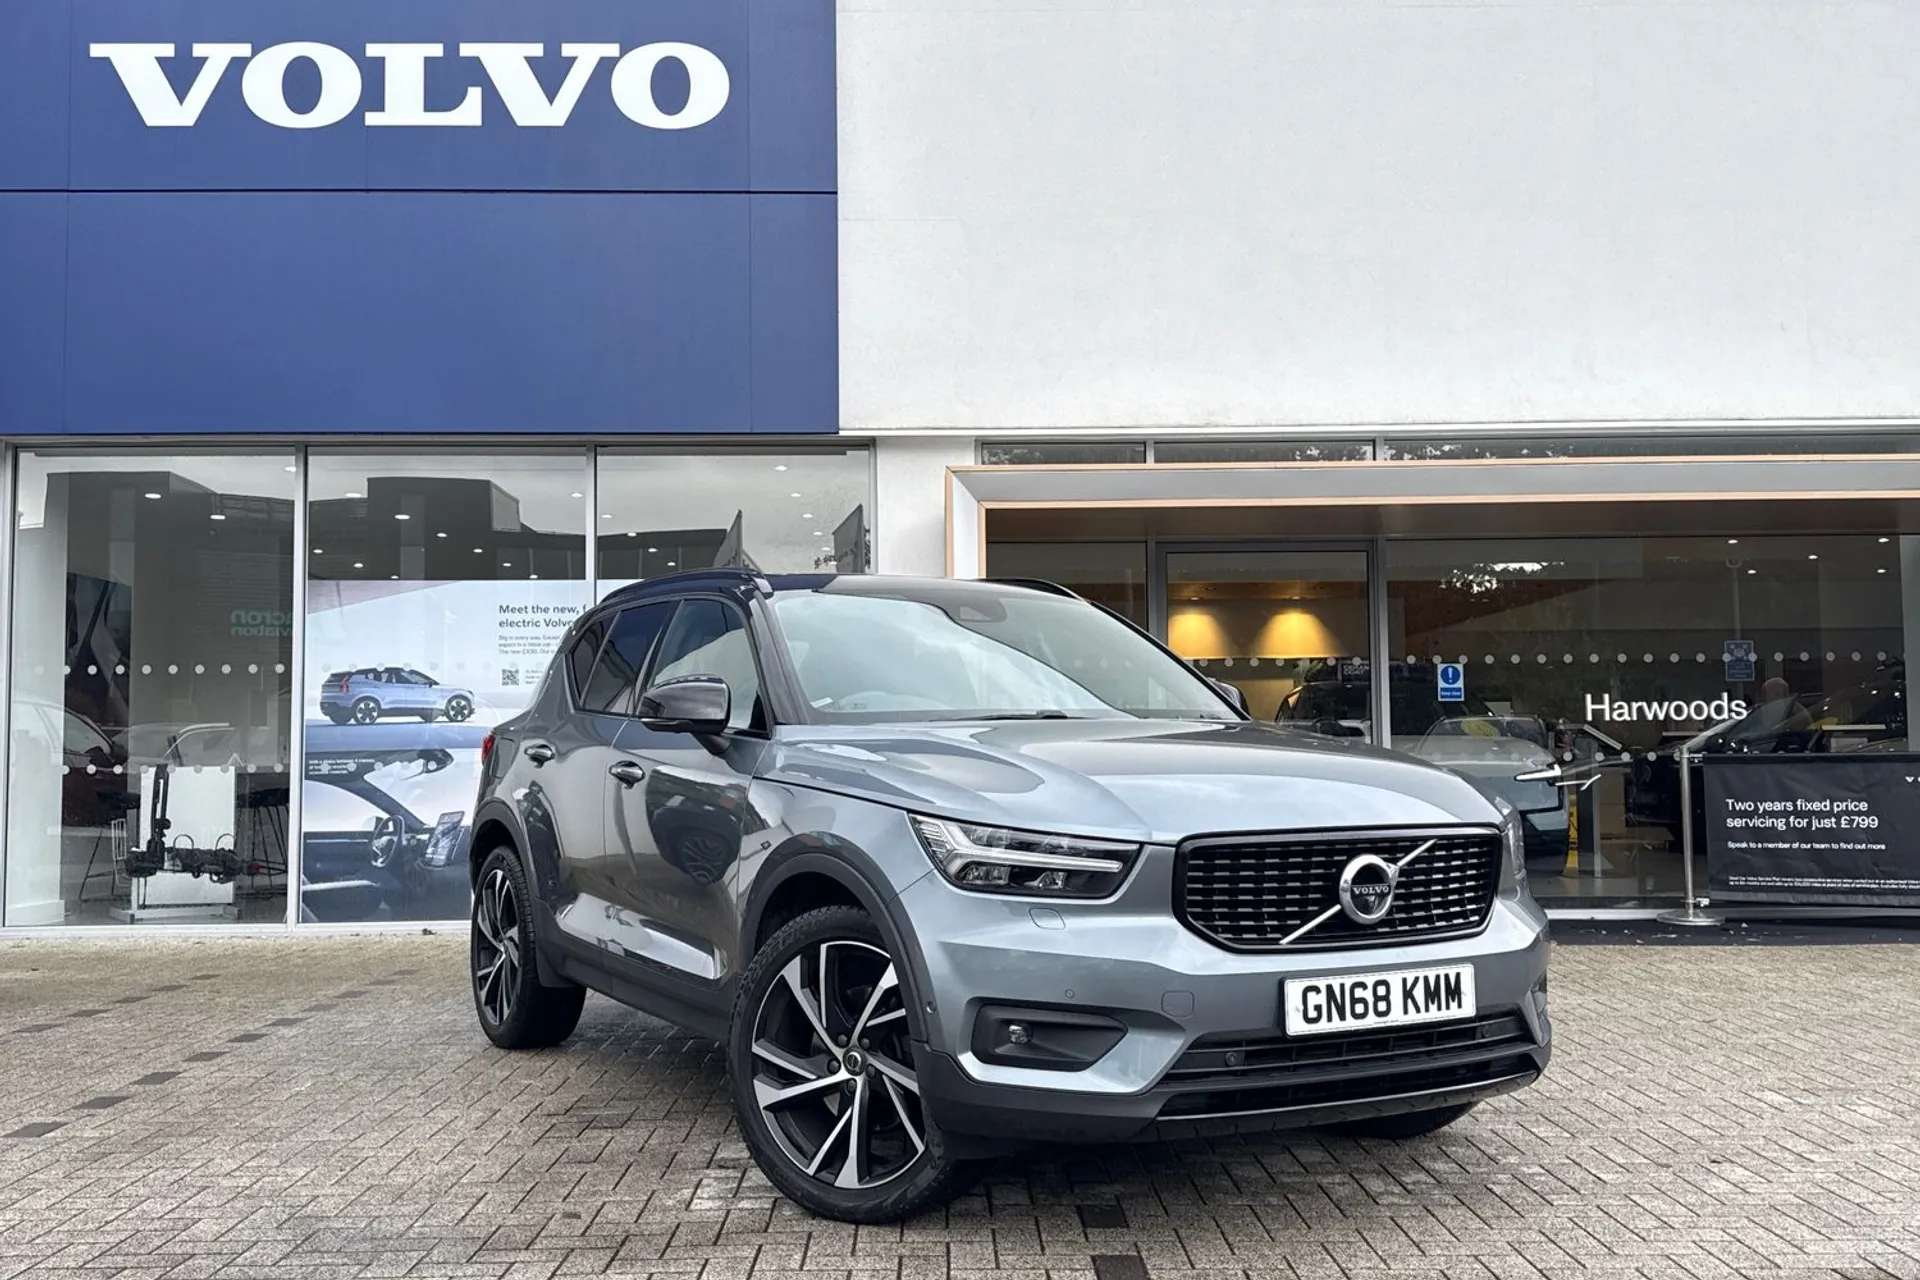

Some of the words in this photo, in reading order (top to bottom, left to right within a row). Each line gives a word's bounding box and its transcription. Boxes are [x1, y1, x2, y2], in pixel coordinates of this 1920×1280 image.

[90, 42, 730, 129] VOLVO
[499, 604, 528, 614] Meet
[532, 604, 550, 614] the
[553, 606, 580, 615] new,
[499, 619, 540, 628] electric
[1585, 692, 1748, 722] Harwoods
[1726, 799, 1754, 811] Two
[1757, 801, 1794, 813] years
[1796, 799, 1830, 811] fixed
[1833, 799, 1868, 813] price
[1726, 816, 1786, 830] servicing
[1789, 816, 1809, 828] for
[1811, 816, 1837, 830] just
[1841, 816, 1879, 829] £799
[1727, 841, 1748, 850] Speak
[1352, 885, 1389, 895] VOLVO
[1302, 979, 1391, 1024] GN68
[1401, 972, 1463, 1015] KMM
